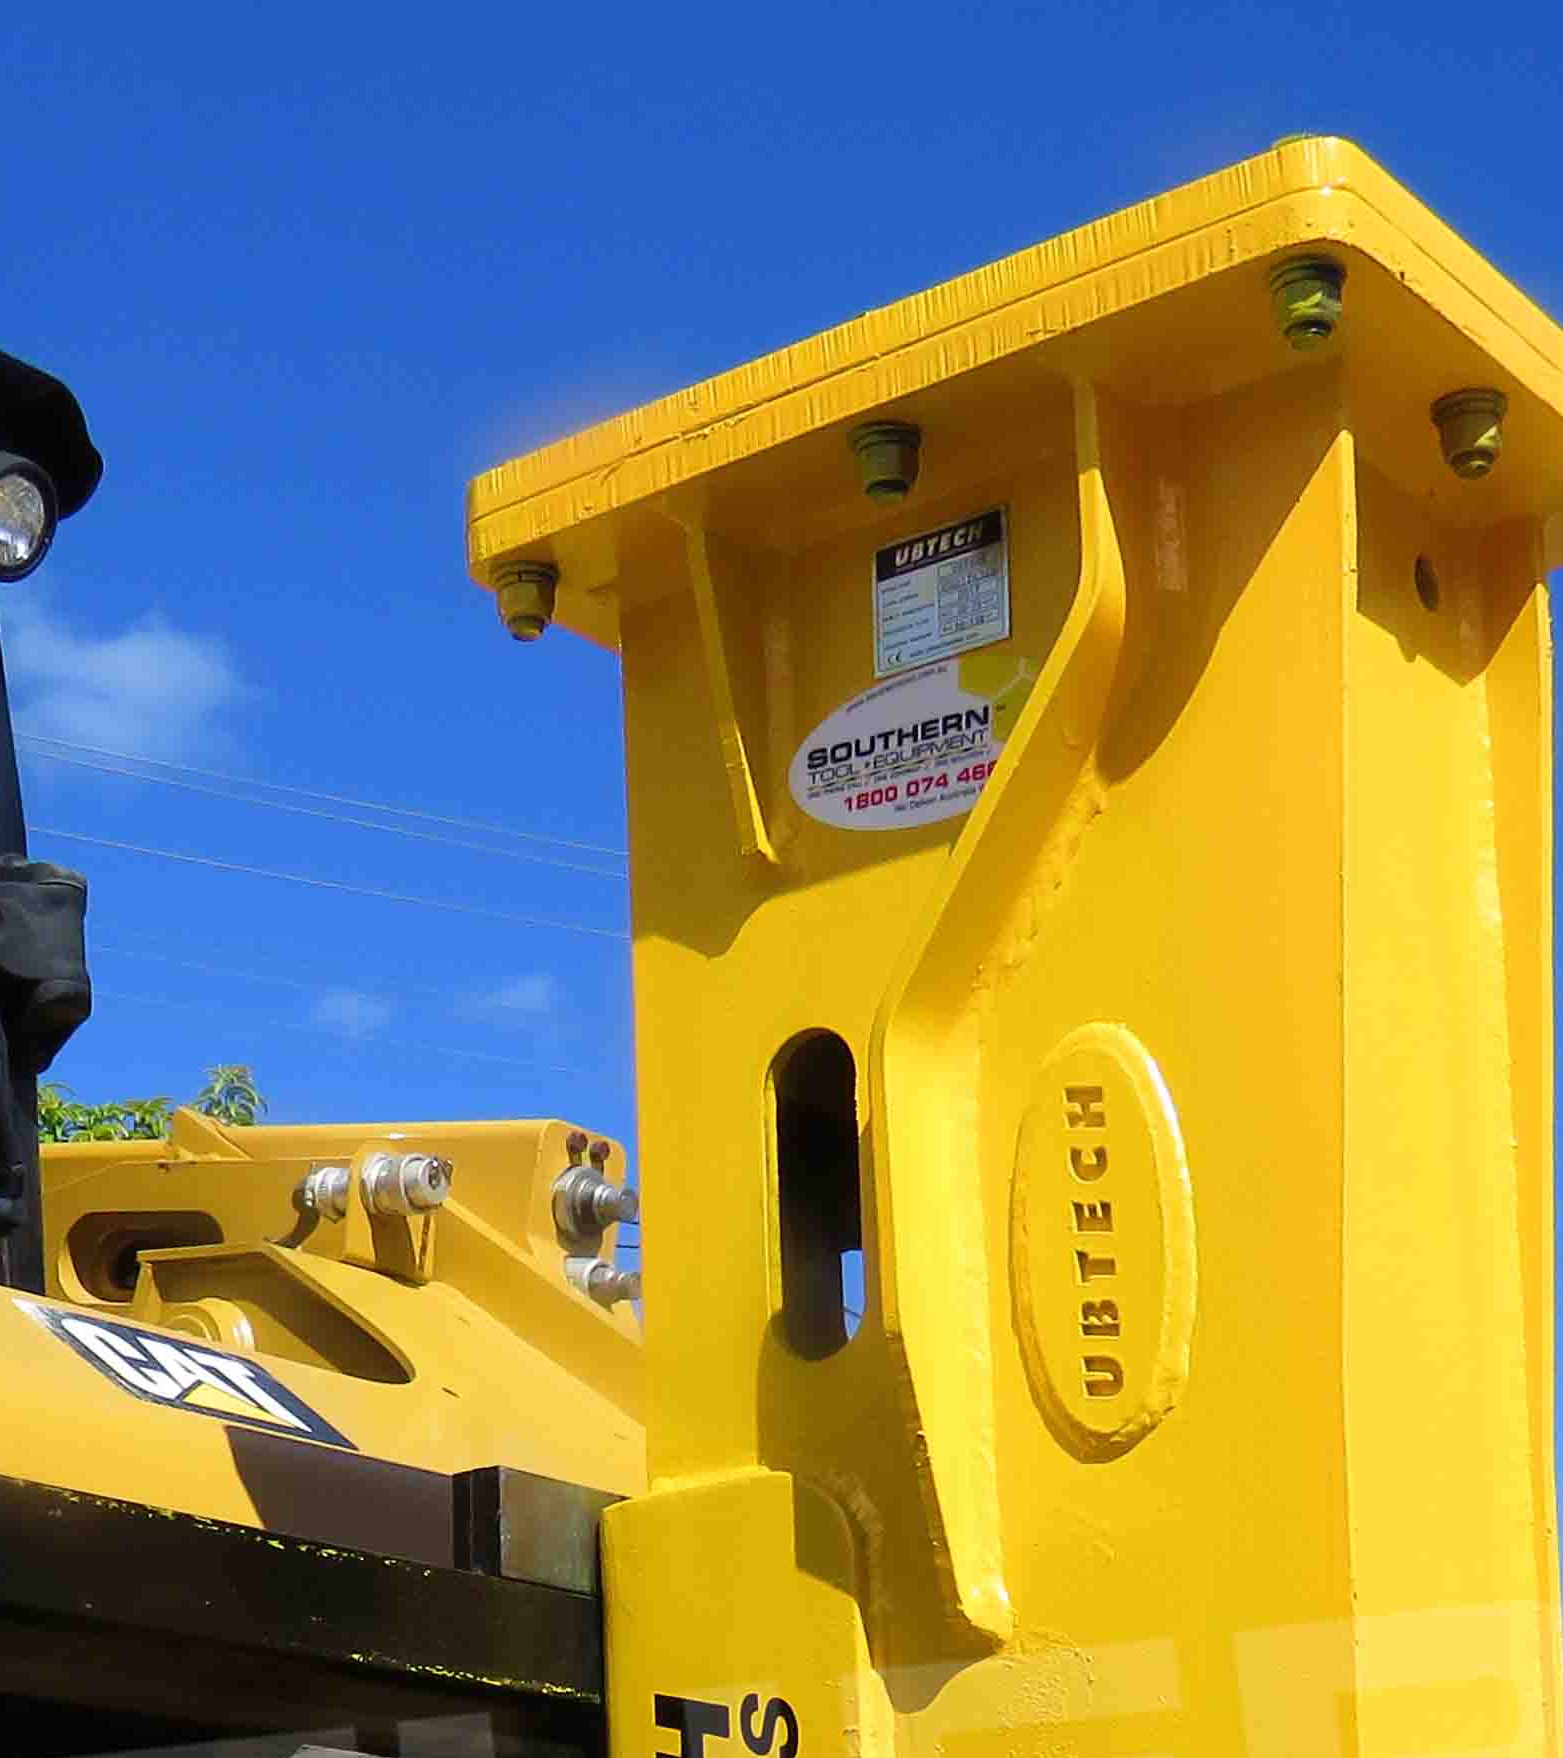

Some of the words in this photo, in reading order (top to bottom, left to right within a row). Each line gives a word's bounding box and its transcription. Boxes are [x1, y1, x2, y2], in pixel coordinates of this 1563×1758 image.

[894, 521, 984, 568] UBTECH
[807, 703, 990, 771] SOUTHERN
[808, 758, 862, 784] TOOL
[873, 727, 990, 771] EQUIPMENT
[844, 786, 899, 813] 1800
[906, 768, 950, 798] 074
[1063, 1083, 1125, 1399] UBTECH
[60, 1316, 314, 1433] CAT
